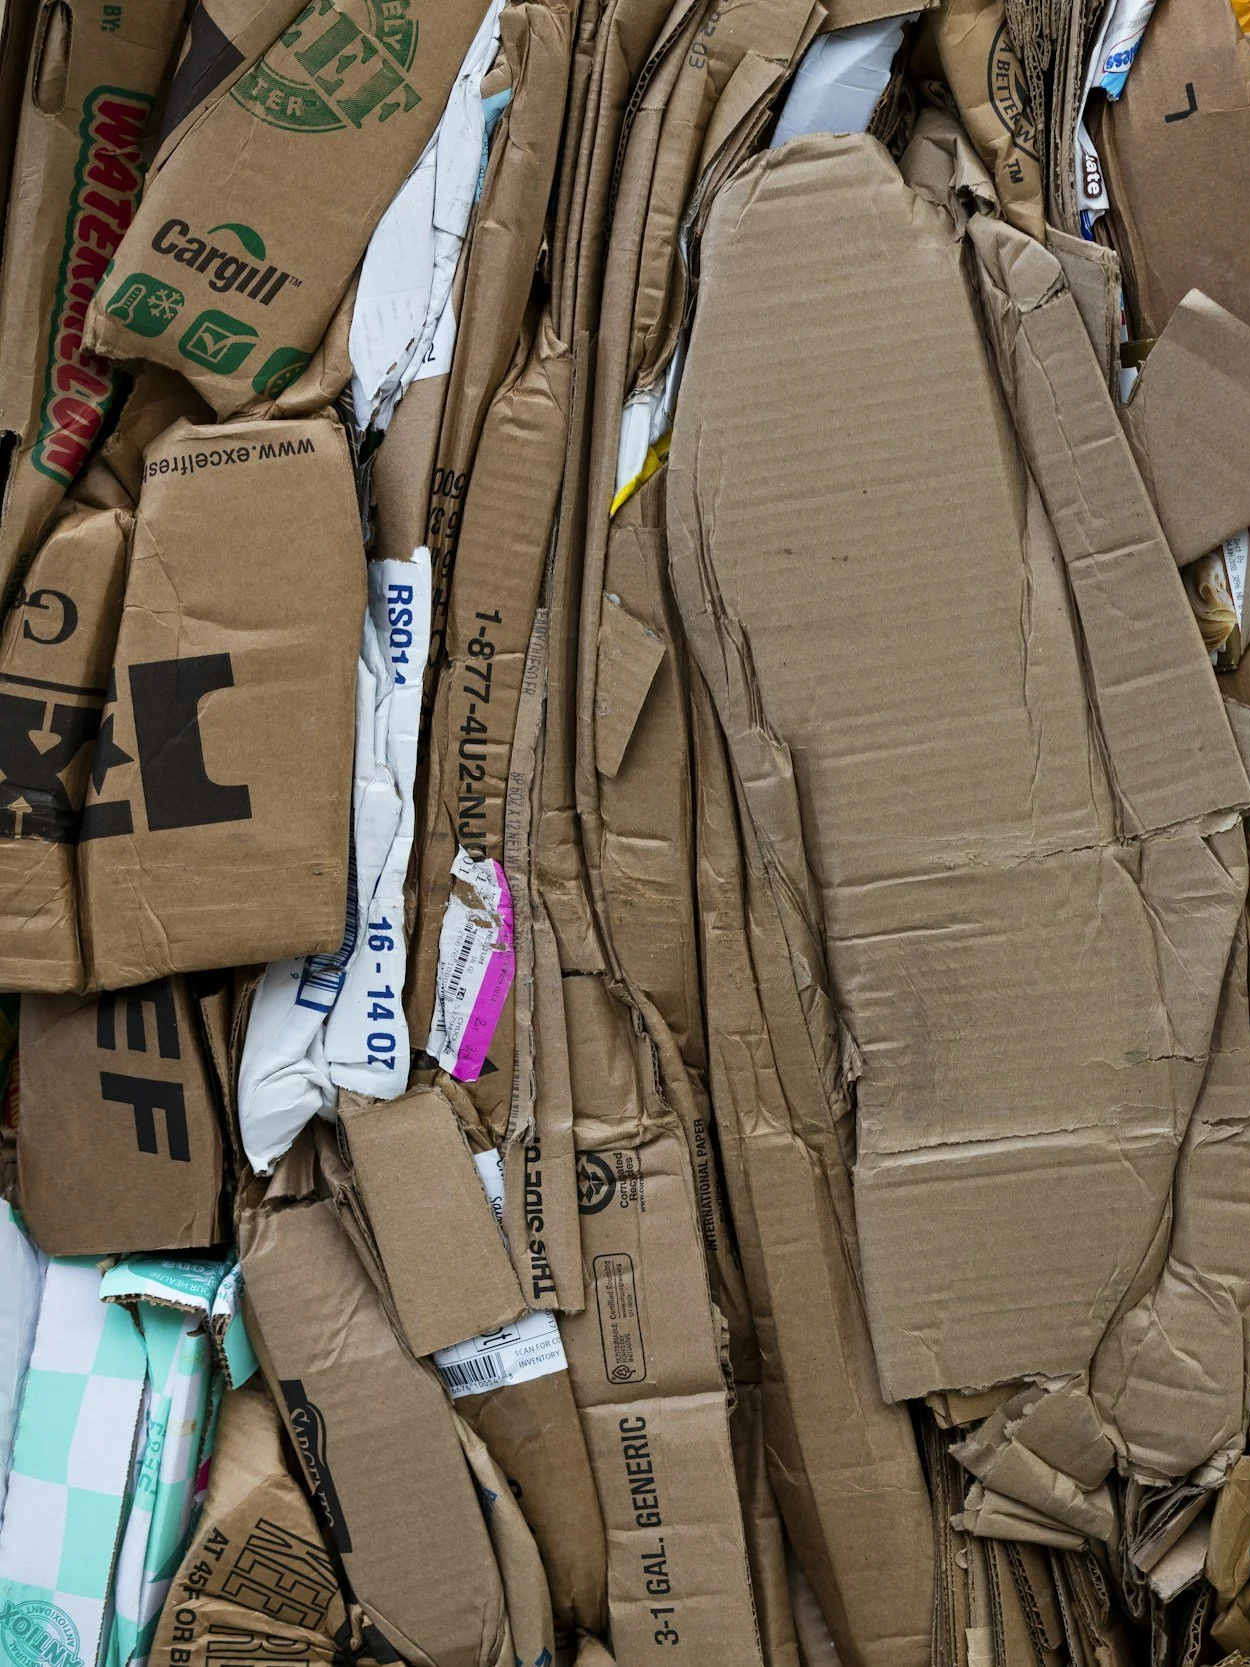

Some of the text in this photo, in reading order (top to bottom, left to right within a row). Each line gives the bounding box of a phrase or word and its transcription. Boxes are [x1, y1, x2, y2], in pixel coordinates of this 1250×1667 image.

[995, 59, 1028, 129] BETTER
[45, 99, 150, 476] WATERMELON
[152, 219, 290, 306] Cargill
[368, 917, 394, 952] 16
[367, 985, 395, 1021] 14
[524, 1170, 545, 1234] SIDE
[614, 1152, 630, 1209] Corrugated
[624, 1156, 637, 1202] Recycles
[694, 1116, 718, 1252] INTERNATIONAL PAPER
[602, 1259, 616, 1321] Certified Sourcing
[514, 1345, 535, 1358] SCAN
[536, 1340, 551, 1353] FOR
[518, 1350, 560, 1369] INVENTORY
[204, 1527, 230, 1562] AT
[621, 1415, 679, 1646] 3-1 GAL. GENERIC
[221, 1517, 340, 1631] KEE
[27, 1606, 75, 1647] ANTIOXIDANT
[172, 1608, 197, 1643] OR
